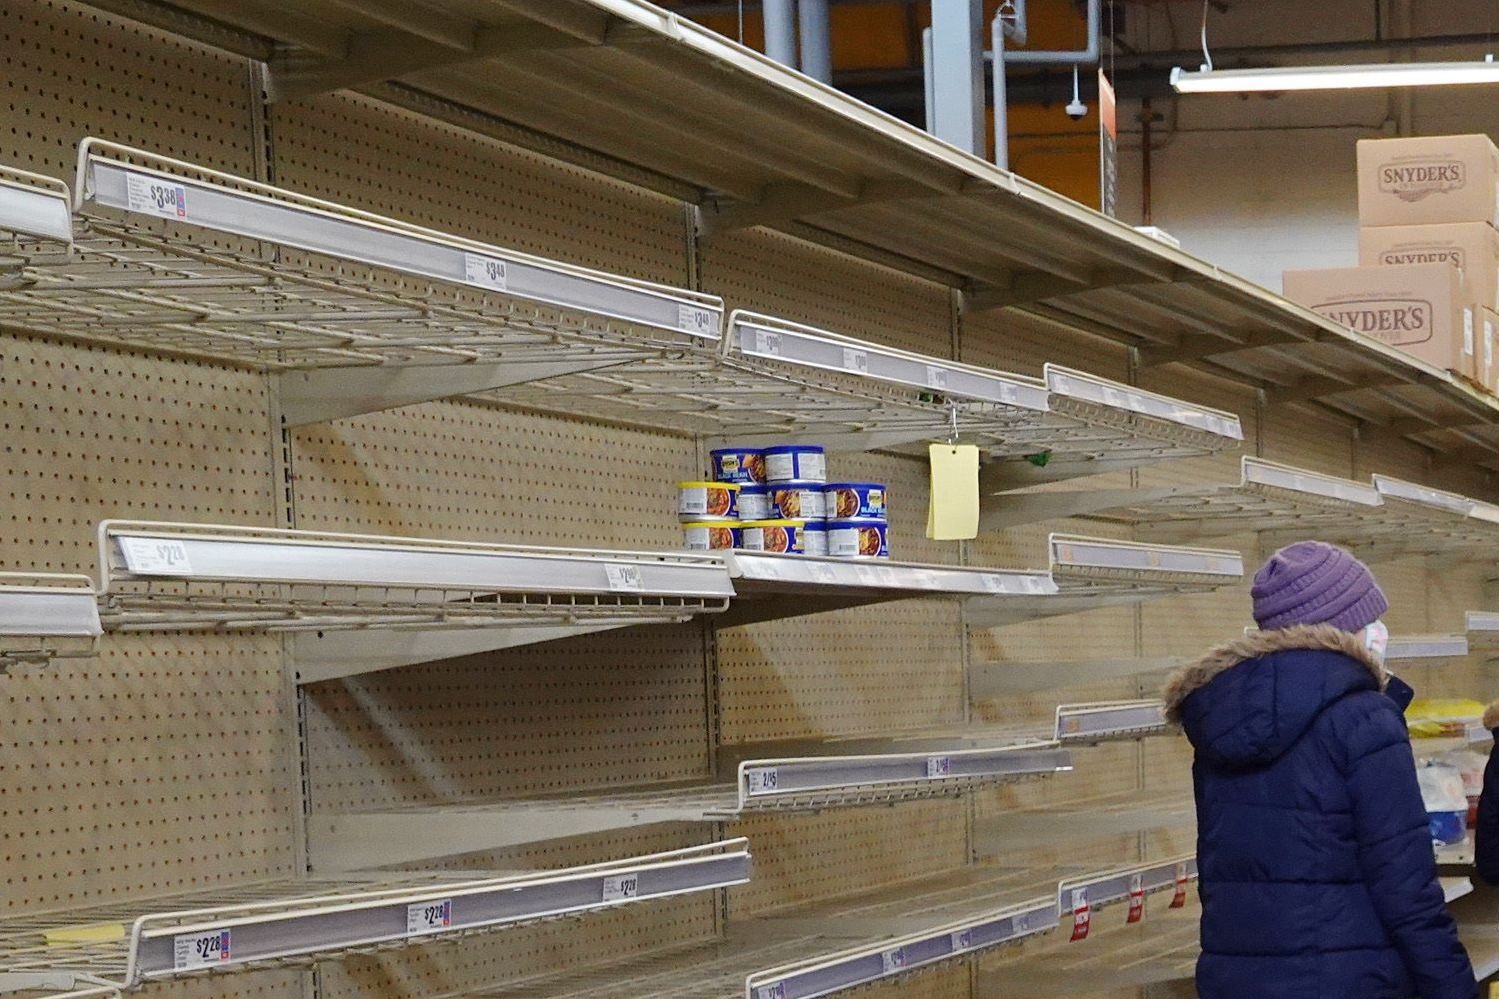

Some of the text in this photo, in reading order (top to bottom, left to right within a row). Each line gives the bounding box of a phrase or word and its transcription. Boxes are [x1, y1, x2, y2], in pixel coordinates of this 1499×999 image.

[1383, 164, 1460, 184] SNYDER'S
[1320, 305, 1424, 332] NYDER'S
[196, 936, 220, 958] $228
